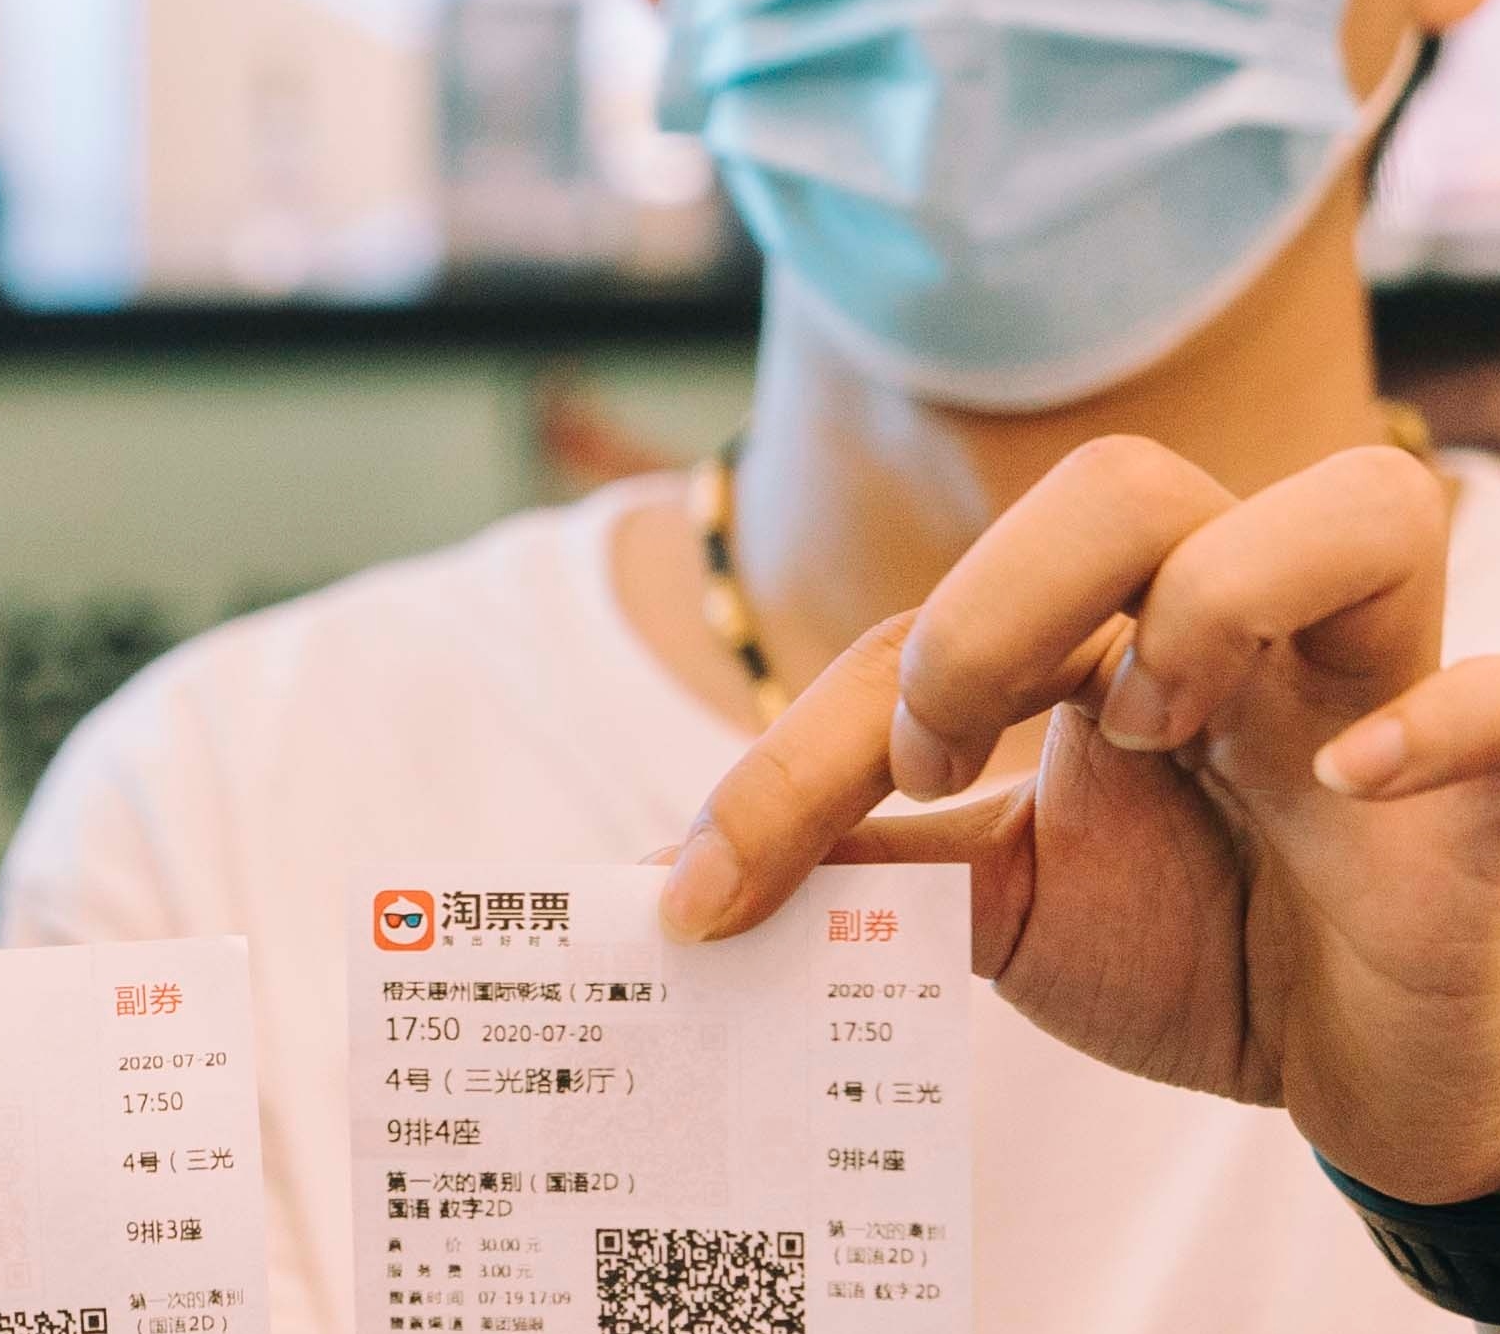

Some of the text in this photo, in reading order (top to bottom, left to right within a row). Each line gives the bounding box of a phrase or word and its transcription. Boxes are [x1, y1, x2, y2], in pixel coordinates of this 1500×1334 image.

[441, 890, 571, 932] 淘票票
[827, 908, 899, 943] 副券
[114, 982, 184, 1017] 副券
[385, 1015, 604, 1044] 17:50 2020-07-20
[829, 1020, 894, 1043] 17:50
[118, 1051, 228, 1072] 2020-07-20
[122, 1090, 185, 1116] 17:50
[386, 1117, 482, 1148] 9排4座
[827, 1147, 907, 1173] 9排4座
[125, 1217, 205, 1245] 9排3座
